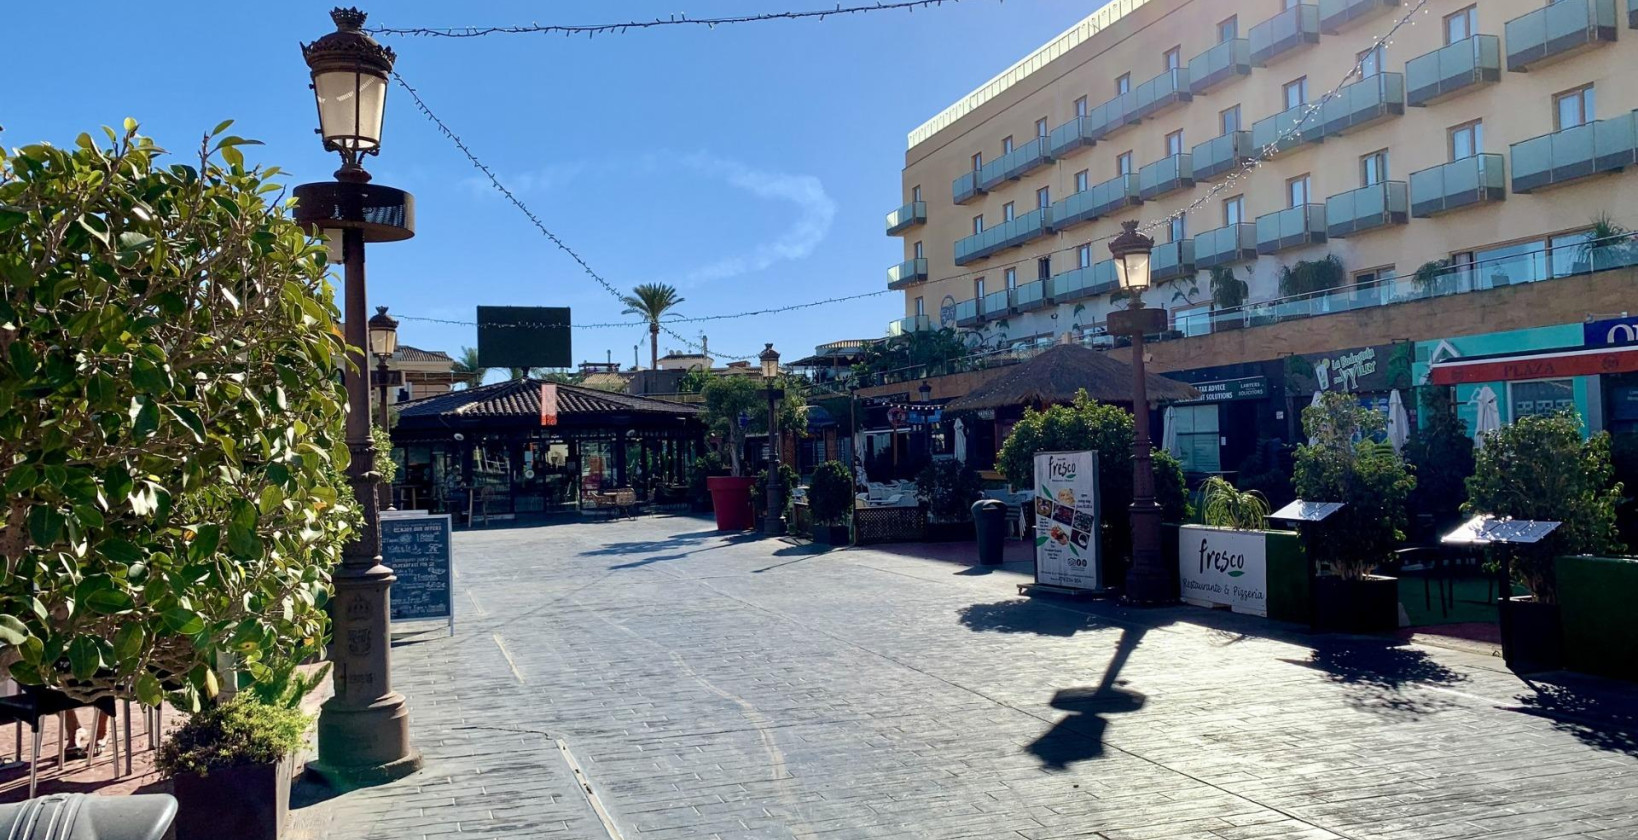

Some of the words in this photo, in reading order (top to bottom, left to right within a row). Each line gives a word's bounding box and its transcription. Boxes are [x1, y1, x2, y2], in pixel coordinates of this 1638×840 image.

[1331, 359, 1341, 371] La
[1503, 362, 1556, 378] PLAZA
[1206, 391, 1233, 400] SOLUTIONS
[1208, 383, 1226, 392] ADVICE
[1048, 455, 1076, 480] fresco
[1199, 538, 1244, 574] fresco
[1182, 578, 1222, 594] Restaurante
[1224, 584, 1230, 595] &
[1233, 585, 1264, 601] Pizzeria
